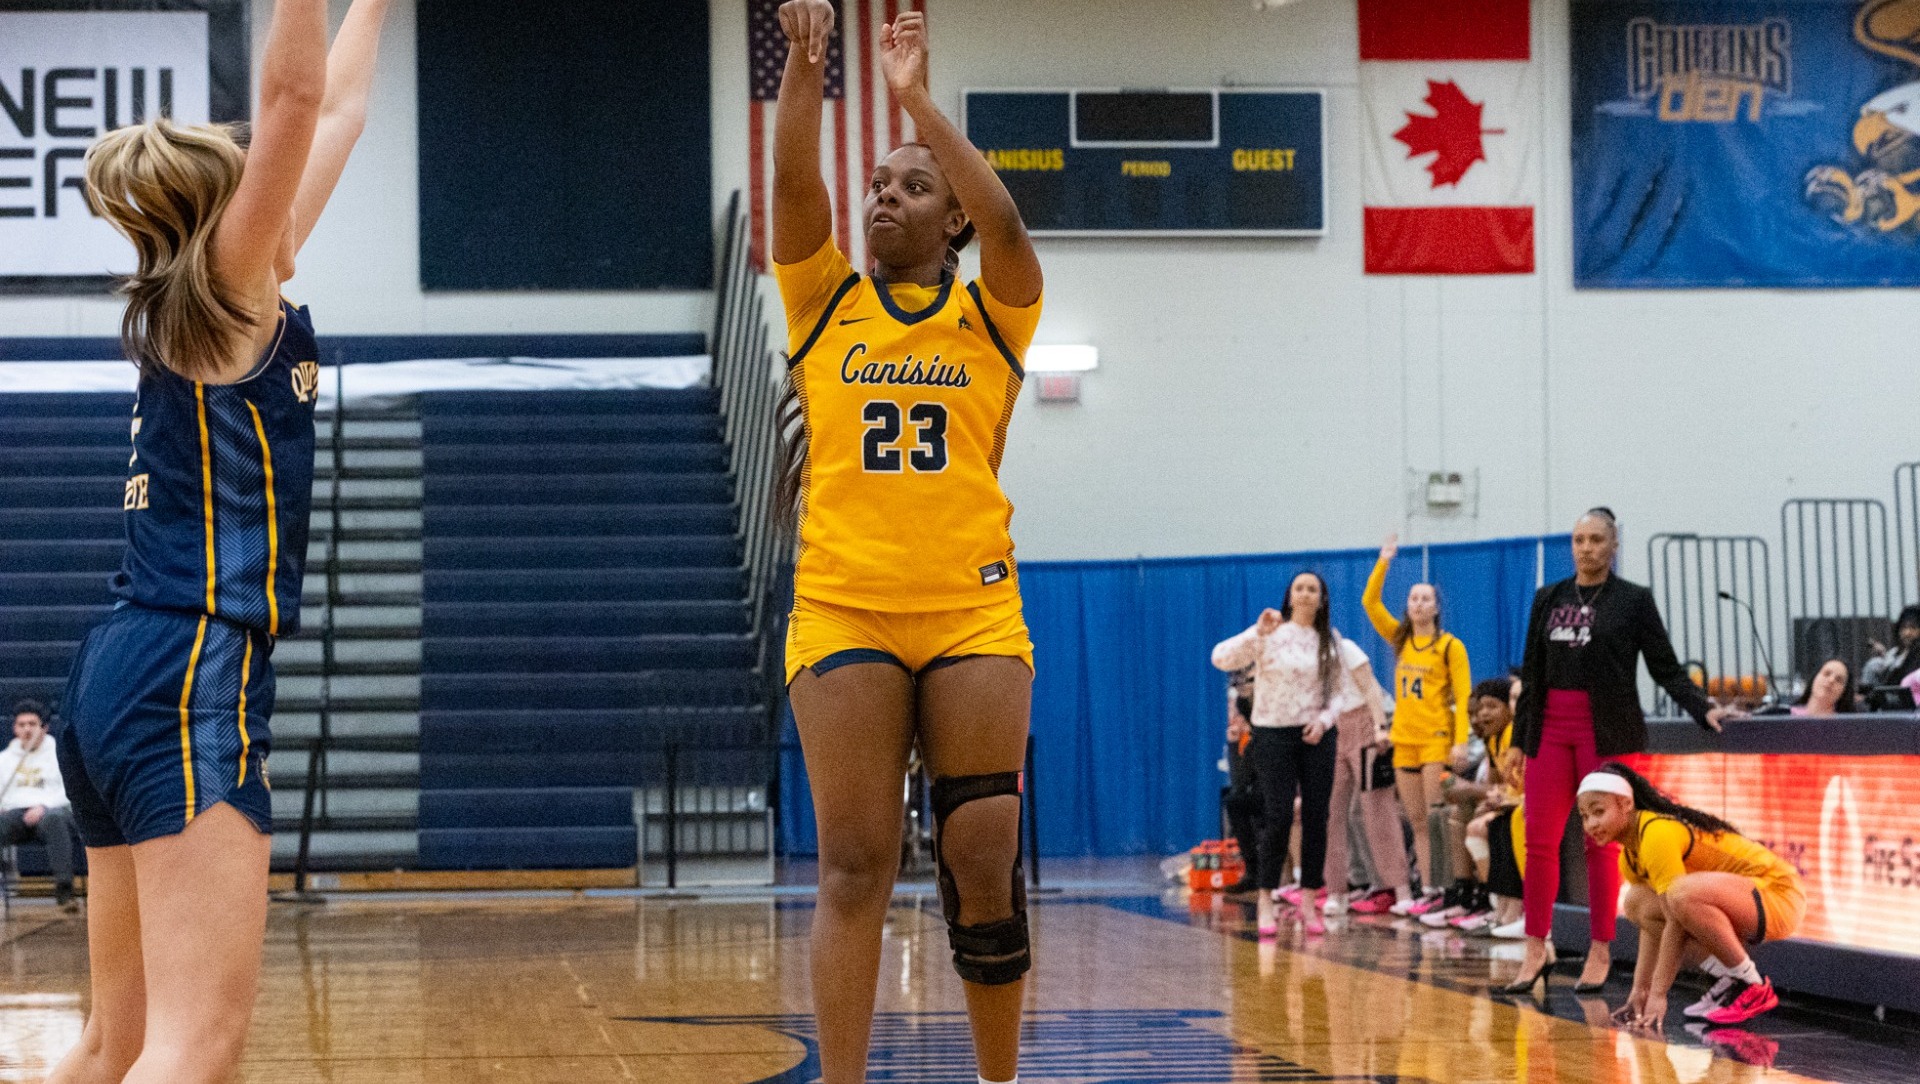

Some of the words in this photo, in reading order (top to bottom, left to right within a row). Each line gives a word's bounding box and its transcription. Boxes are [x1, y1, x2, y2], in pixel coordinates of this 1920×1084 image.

[1627, 16, 1793, 99] GRIFFINS
[0, 68, 173, 138] NEW
[1658, 68, 1763, 122] den
[978, 148, 1064, 171] ANISIUS
[1121, 160, 1171, 177] PERIOD
[1232, 148, 1296, 171] GUEST
[841, 341, 973, 388] Canisius
[861, 399, 950, 474] 23
[1402, 675, 1423, 700] 14
